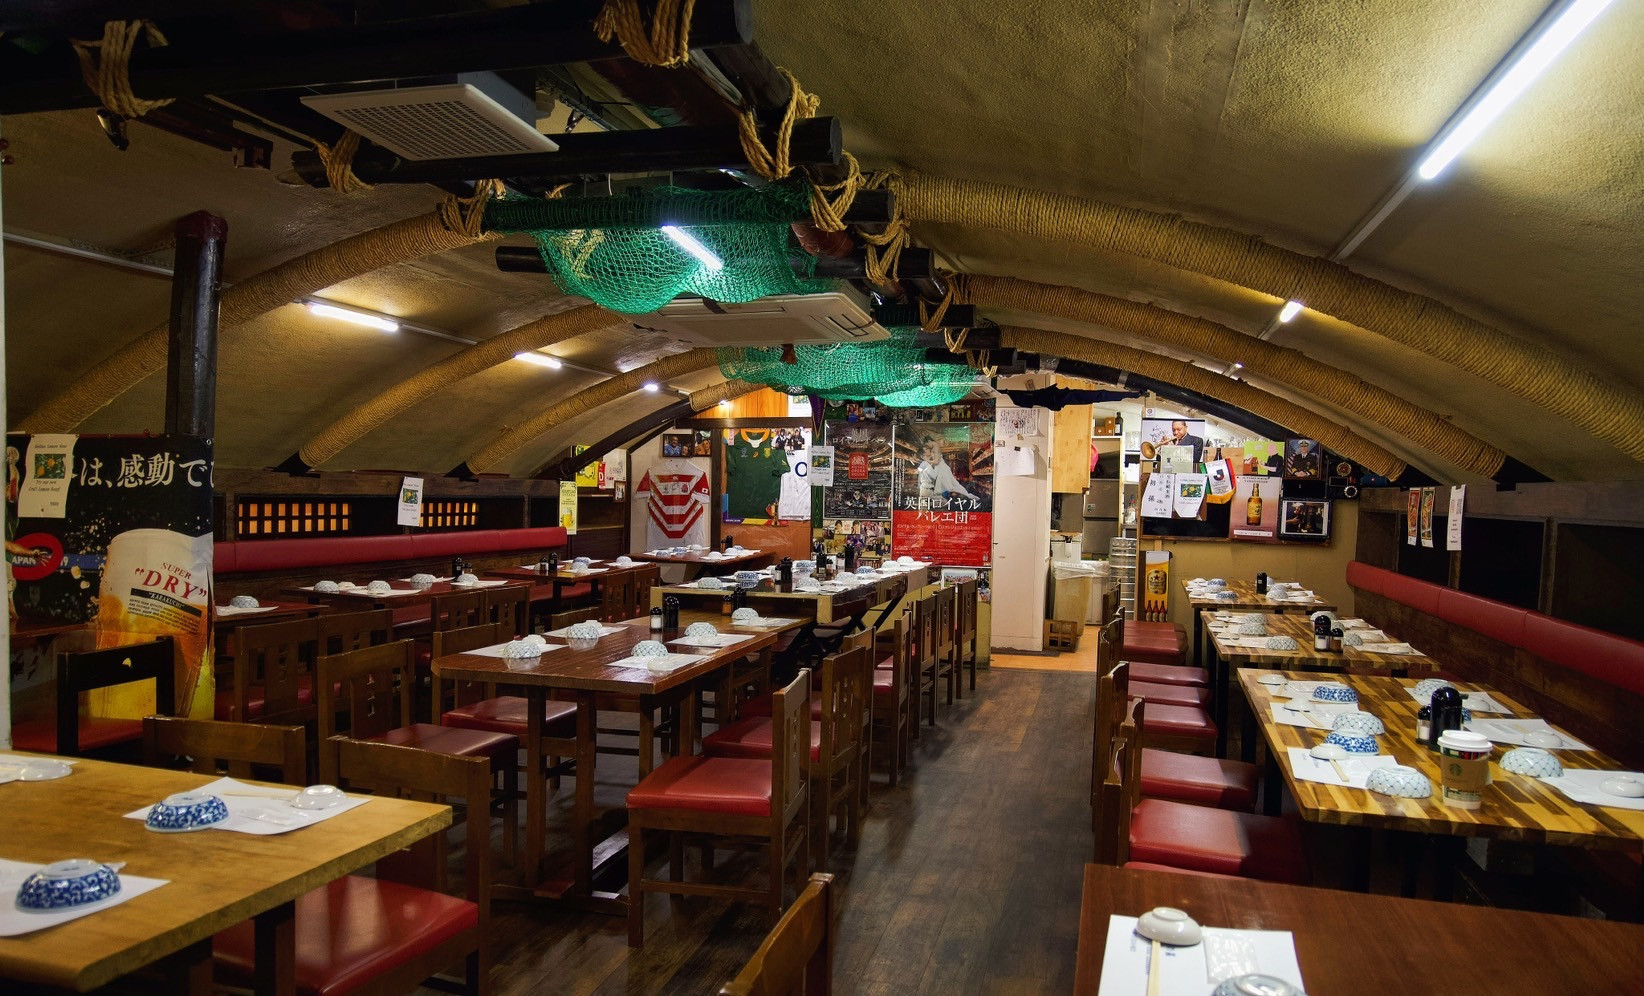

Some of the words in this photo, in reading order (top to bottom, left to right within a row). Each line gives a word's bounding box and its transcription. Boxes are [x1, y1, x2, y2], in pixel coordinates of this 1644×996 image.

[80, 452, 214, 489] は、感動で
[904, 496, 982, 510] 英国ロイヤル
[916, 511, 968, 524] バレエ団
[12, 556, 36, 565] APAN
[161, 562, 192, 580] SUPER
